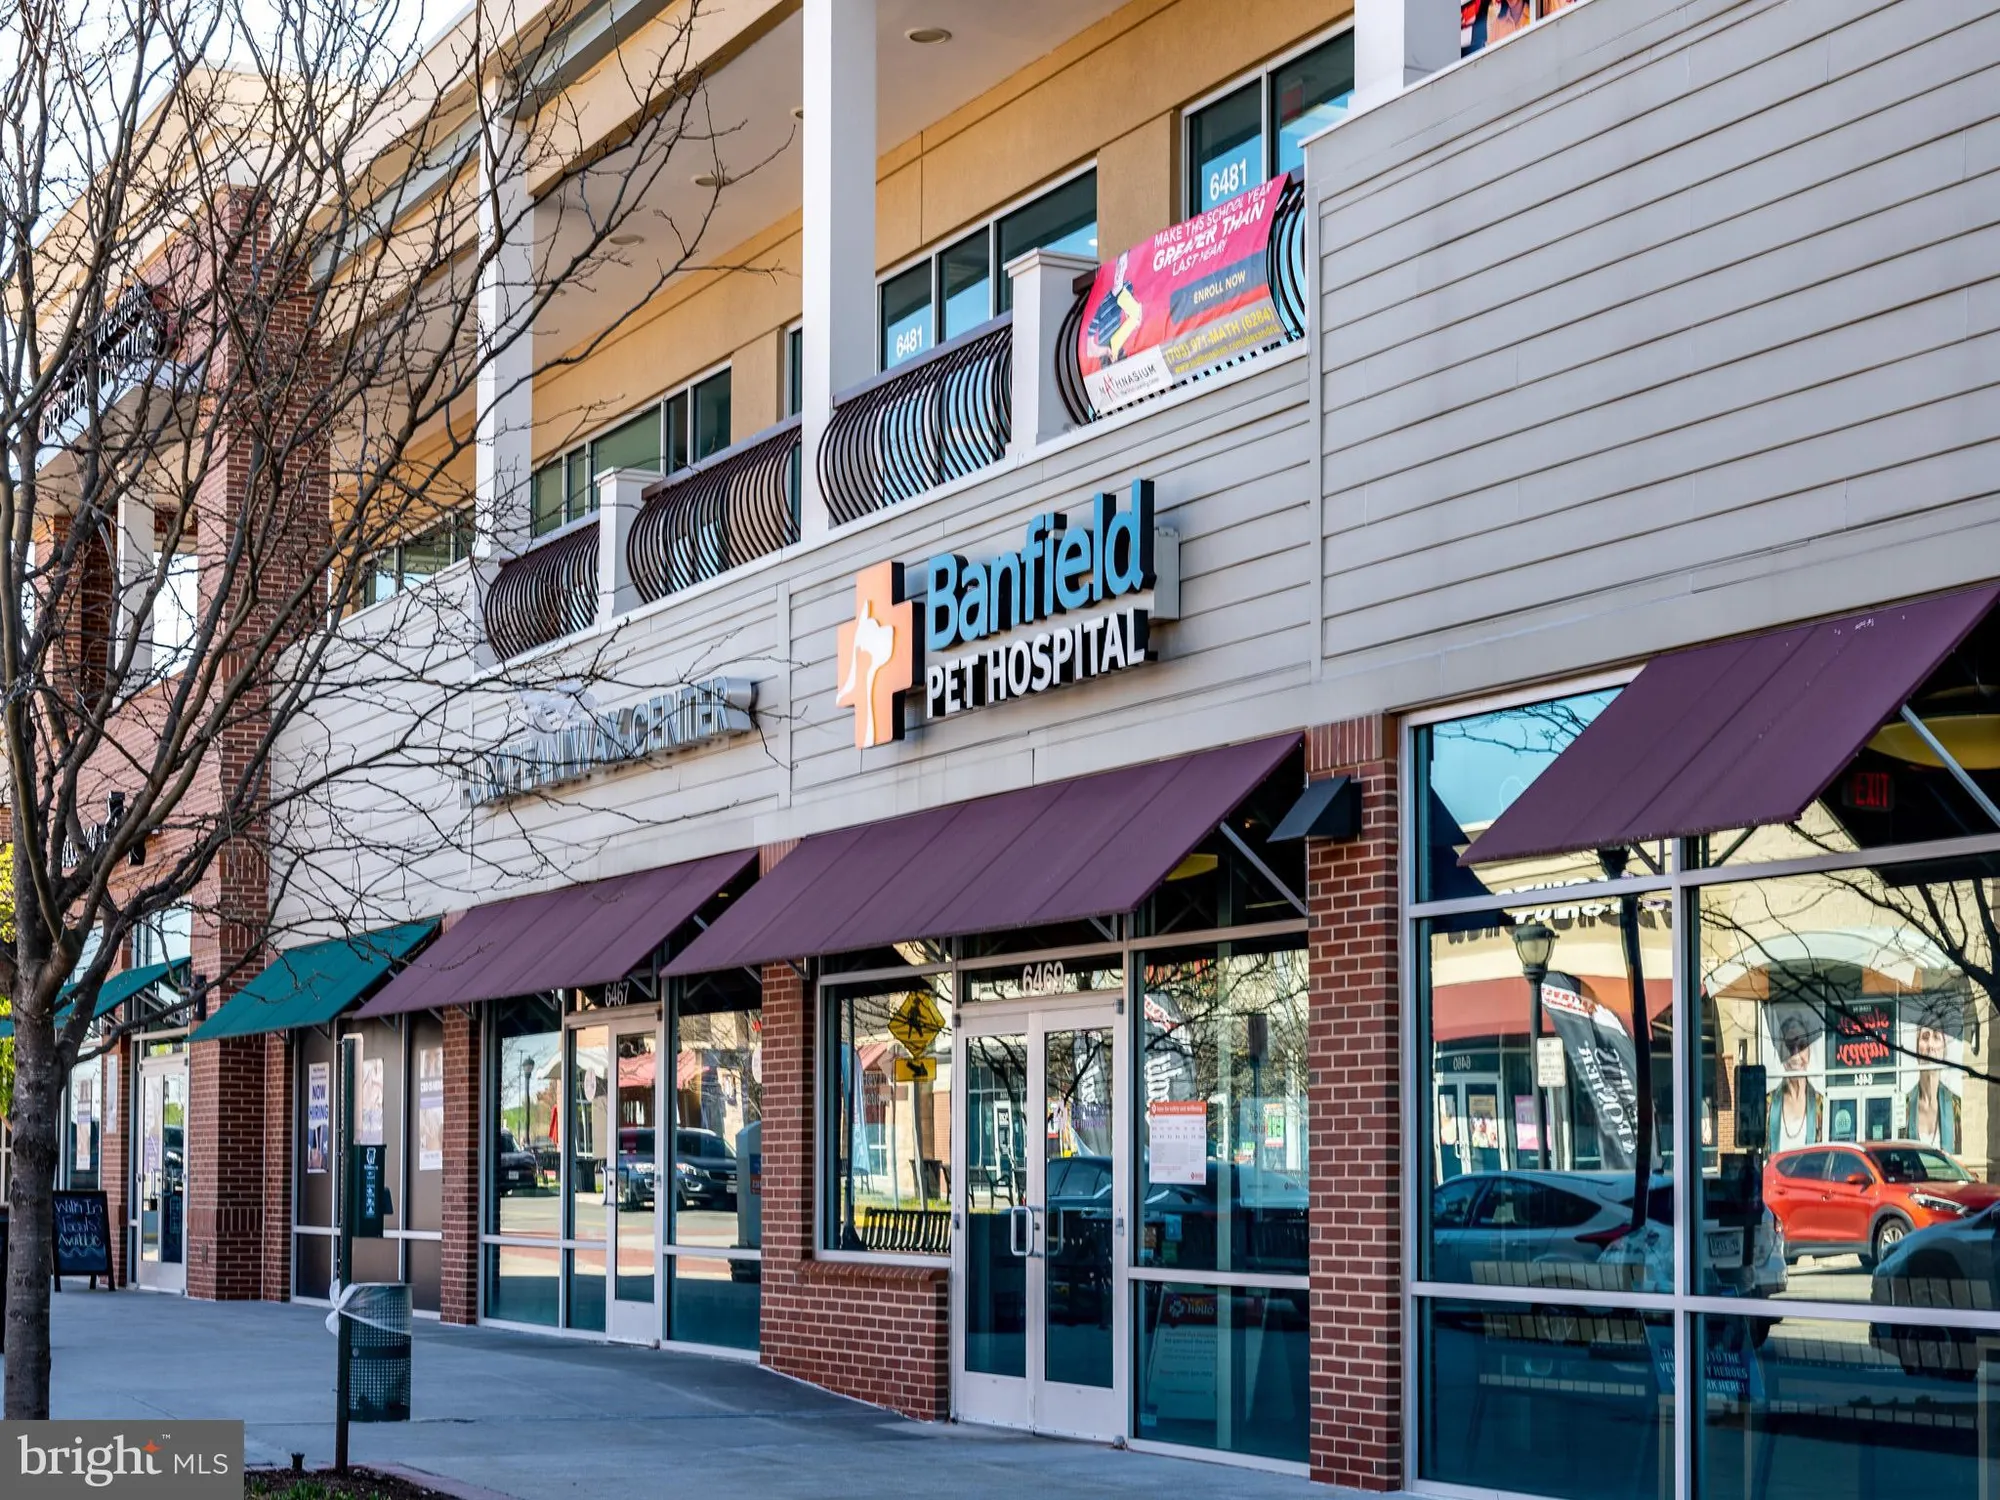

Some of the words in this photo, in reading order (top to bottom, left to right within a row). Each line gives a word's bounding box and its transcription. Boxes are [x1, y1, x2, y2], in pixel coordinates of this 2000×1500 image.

[1209, 157, 1248, 201] 6481
[1154, 225, 1183, 249] MAKE
[1206, 196, 1244, 227] SCHOOL
[1221, 199, 1266, 238] THAN
[1172, 253, 1200, 277] LAST
[1193, 284, 1224, 305] ENROLL
[1225, 270, 1246, 291] NOW
[896, 324, 923, 359] 6481
[1190, 319, 1242, 352] 971-MATH
[927, 477, 1146, 652] Banfield
[926, 653, 980, 720] PET
[986, 606, 1147, 704] HOSPITAL
[568, 706, 626, 776] WAX
[629, 676, 732, 758] CENTER
[1854, 772, 1889, 808] EXIT
[604, 981, 630, 1007] 6467
[1022, 960, 1065, 995] 6469
[312, 1084, 327, 1101] NOW
[308, 1104, 329, 1121] HIRING
[1187, 1302, 1215, 1315] hello
